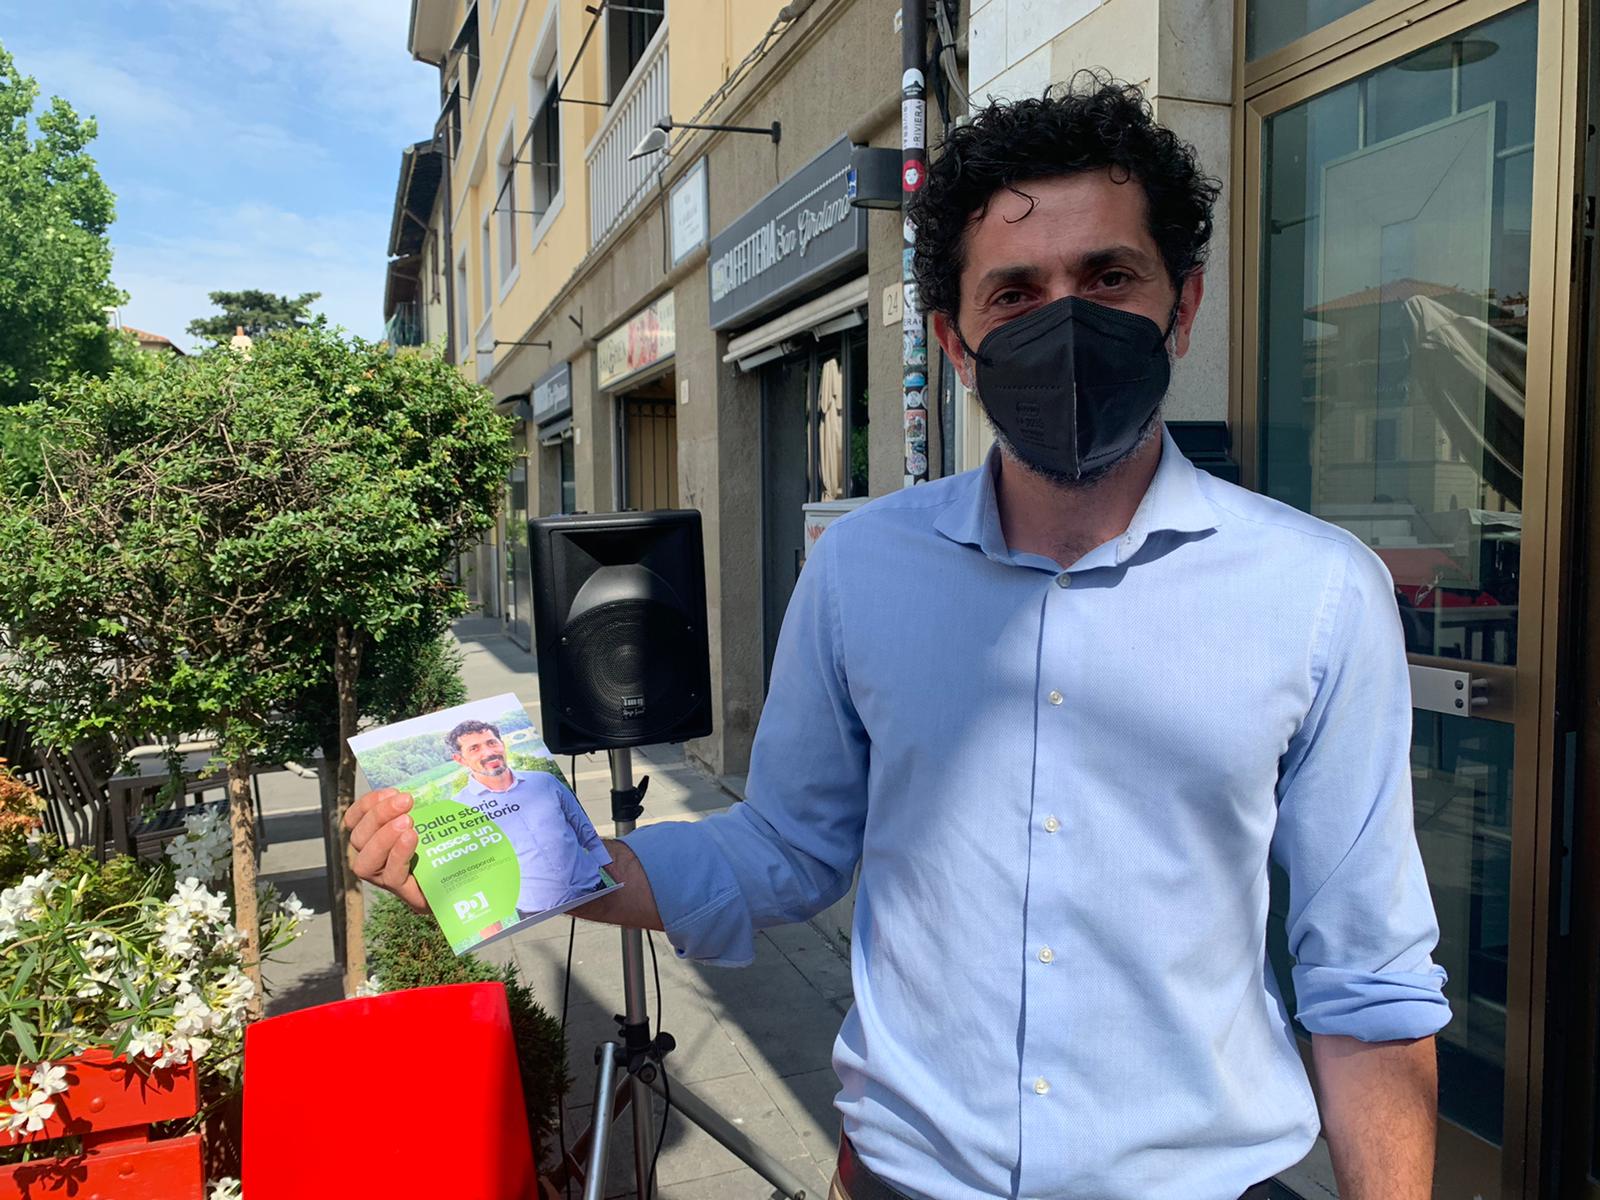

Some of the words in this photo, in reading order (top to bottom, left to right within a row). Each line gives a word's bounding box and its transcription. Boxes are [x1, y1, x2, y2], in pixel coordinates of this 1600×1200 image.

[887, 291, 899, 317] 24
[415, 814, 456, 835] Dalla
[458, 799, 498, 817] storia
[421, 832, 437, 845] di
[437, 826, 458, 838] un
[460, 803, 521, 831] territorio
[425, 833, 472, 857] nasce
[472, 825, 494, 838] un
[431, 842, 479, 869] nuovo
[480, 832, 503, 848] PD
